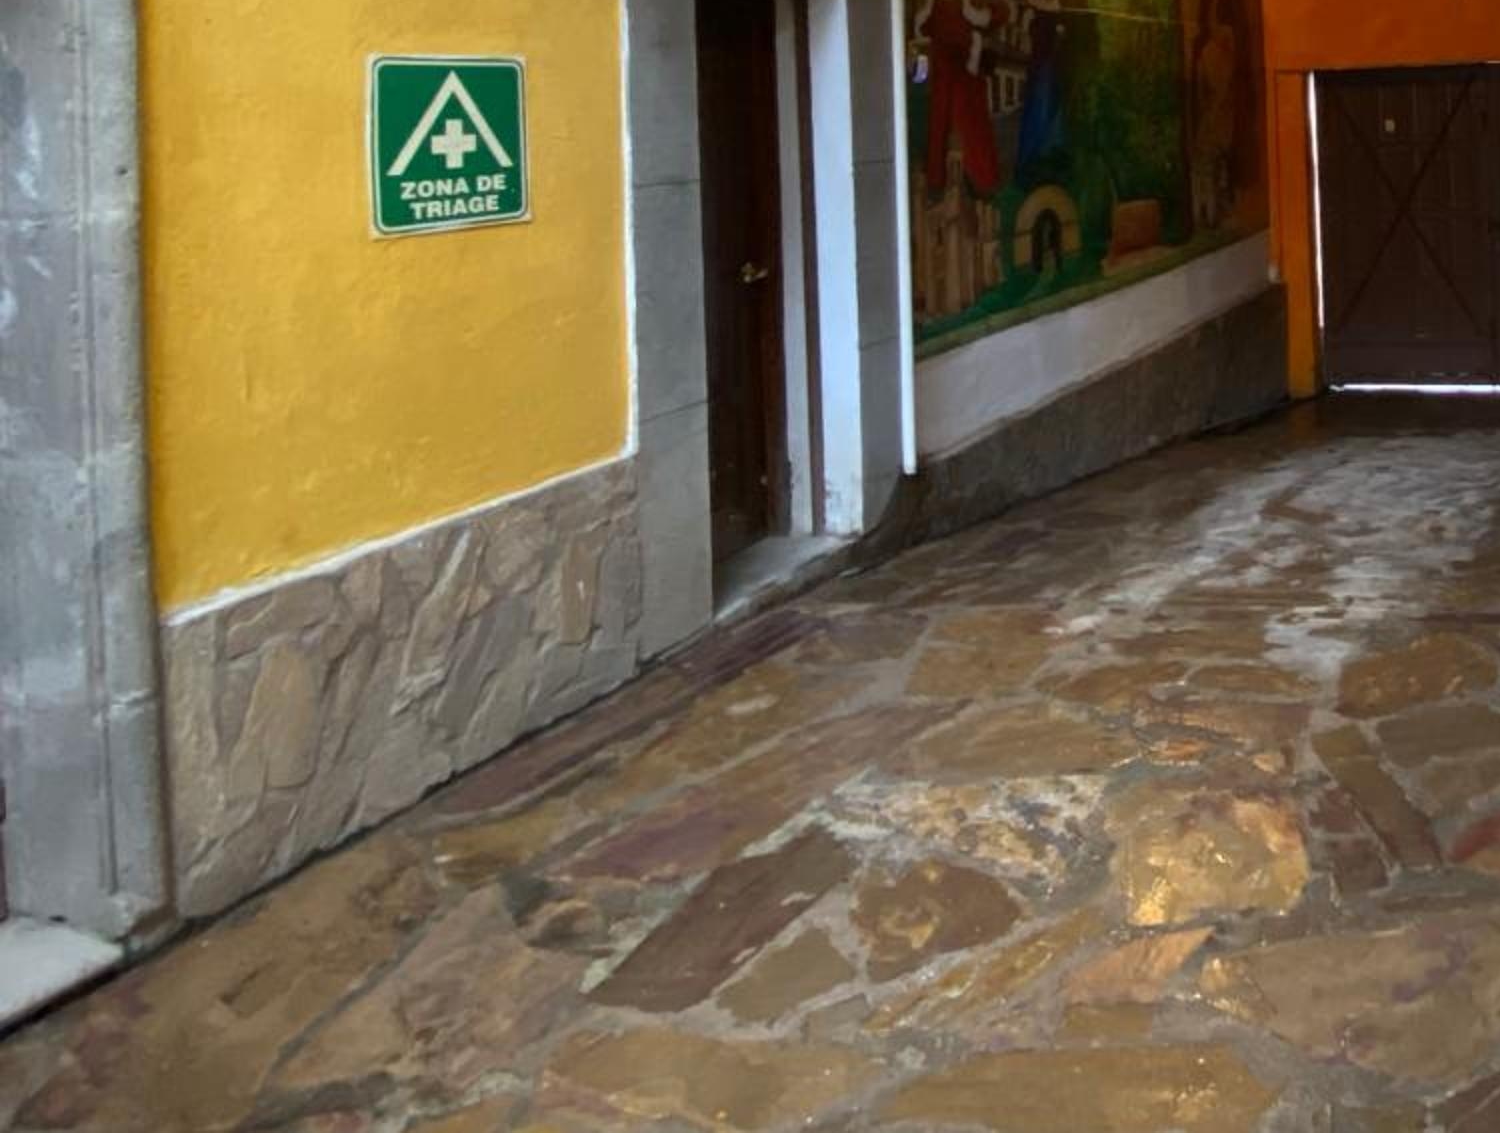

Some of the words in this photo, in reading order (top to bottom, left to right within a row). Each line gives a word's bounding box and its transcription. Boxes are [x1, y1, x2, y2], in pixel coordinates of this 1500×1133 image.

[400, 178, 469, 199] ZONA
[477, 174, 507, 191] DE
[409, 195, 500, 219] TRIAGE
